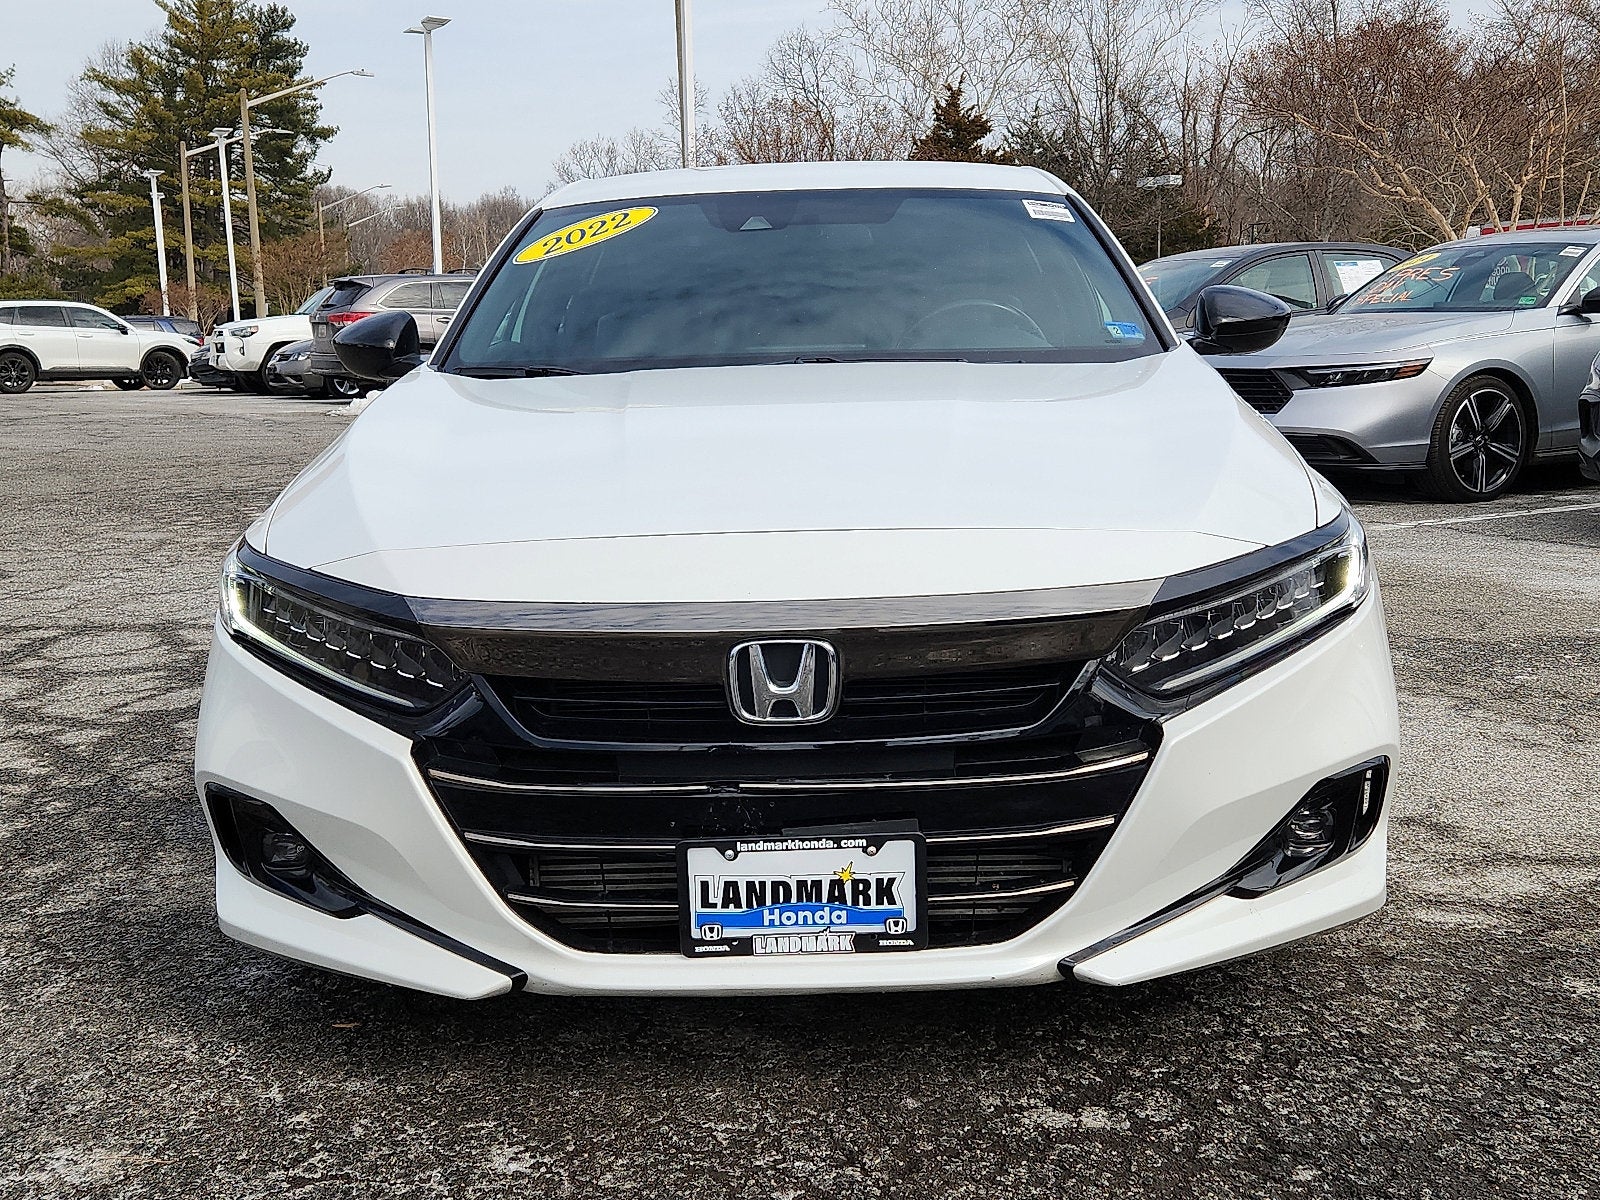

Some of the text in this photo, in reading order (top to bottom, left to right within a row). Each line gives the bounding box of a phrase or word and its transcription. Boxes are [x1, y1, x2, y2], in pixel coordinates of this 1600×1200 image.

[542, 212, 632, 256] 2022
[699, 877, 898, 910] LANDMARK
[763, 907, 848, 926] Honda
[754, 932, 854, 954] LANDMARK
